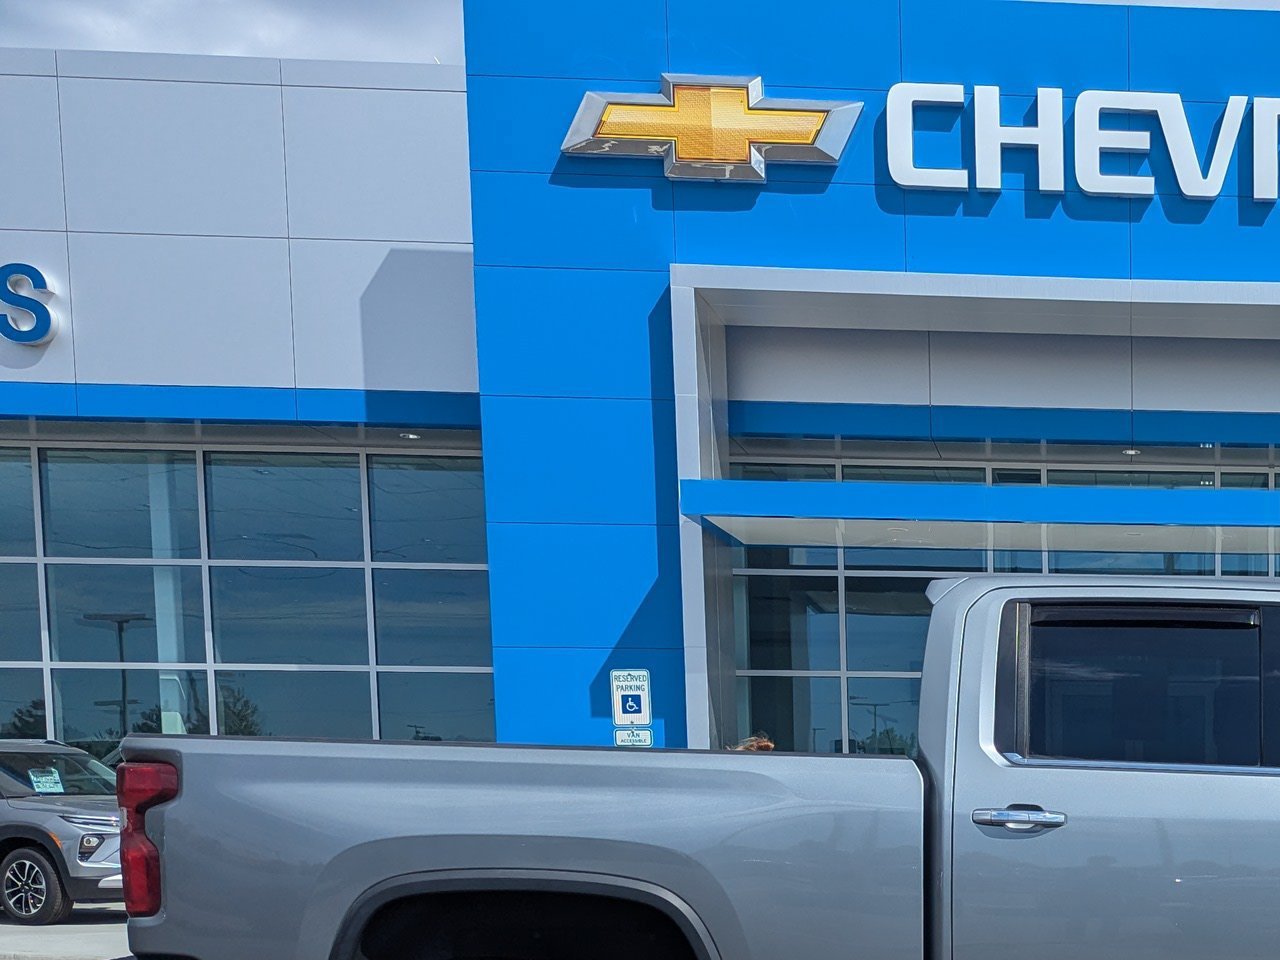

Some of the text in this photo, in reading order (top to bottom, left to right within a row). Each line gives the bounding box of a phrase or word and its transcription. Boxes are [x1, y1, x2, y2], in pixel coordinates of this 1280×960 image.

[0, 263, 51, 343] S
[614, 674, 647, 682] RESERVED
[616, 684, 646, 692] PARKING
